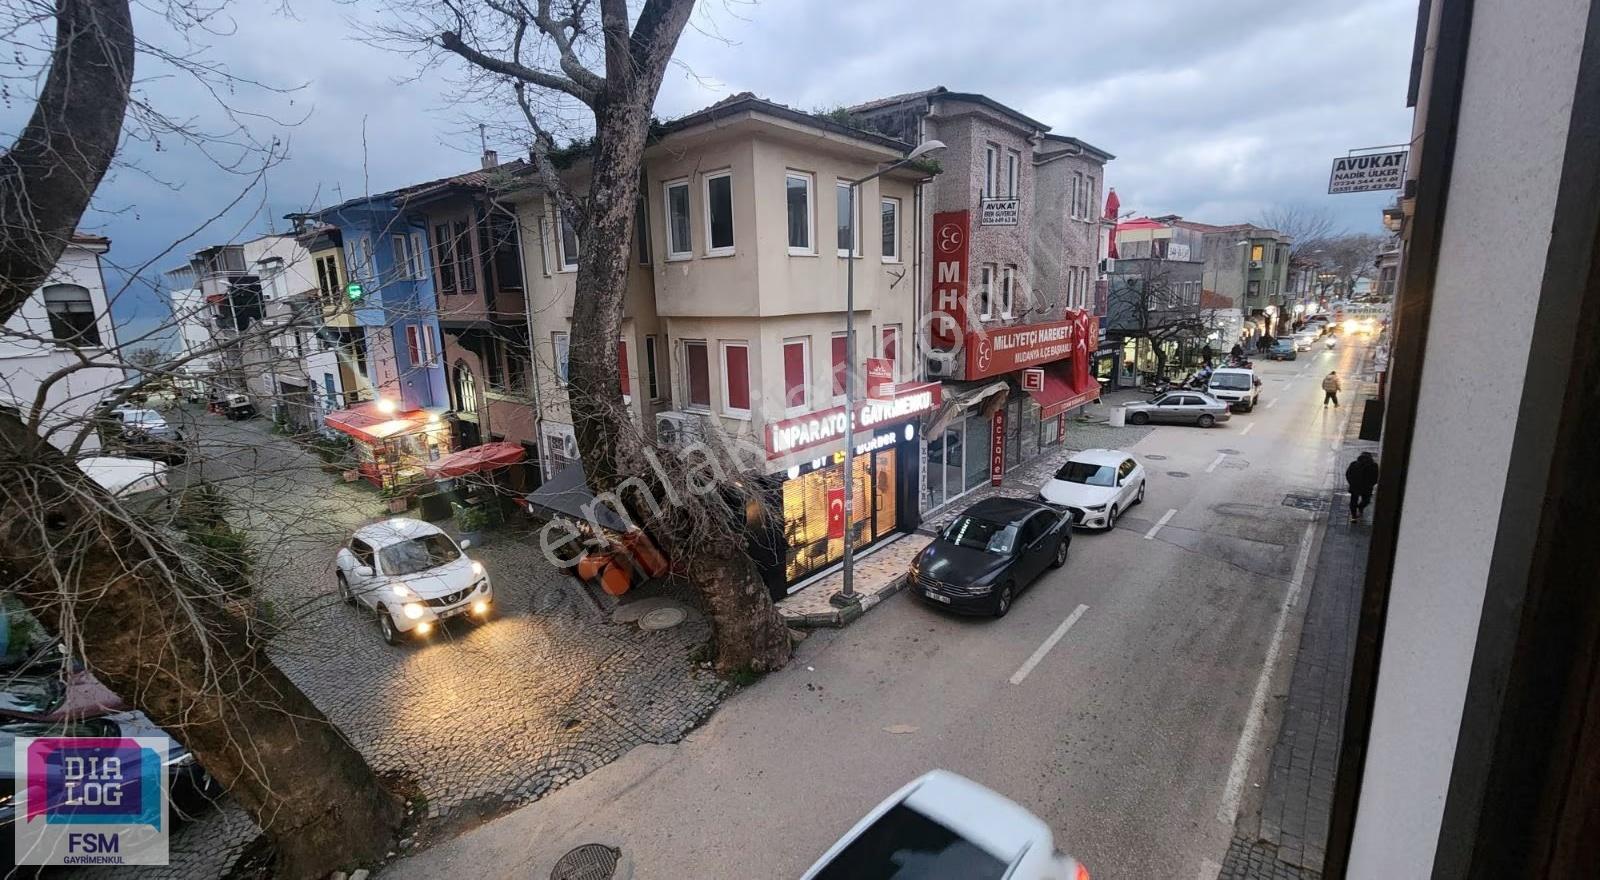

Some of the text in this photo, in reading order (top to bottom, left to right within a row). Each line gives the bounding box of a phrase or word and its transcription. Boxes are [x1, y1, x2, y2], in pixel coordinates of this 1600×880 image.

[1336, 154, 1403, 171] AVUKAT
[1335, 168, 1399, 180] NADİR ÜLKER
[986, 202, 1016, 210] AVUKAT
[938, 261, 960, 337] MHP
[993, 329, 1038, 351] MİLLİYETÇİ
[1039, 326, 1069, 343] HAREKET
[1015, 351, 1039, 364] MUDANYA
[1027, 374, 1038, 387] E
